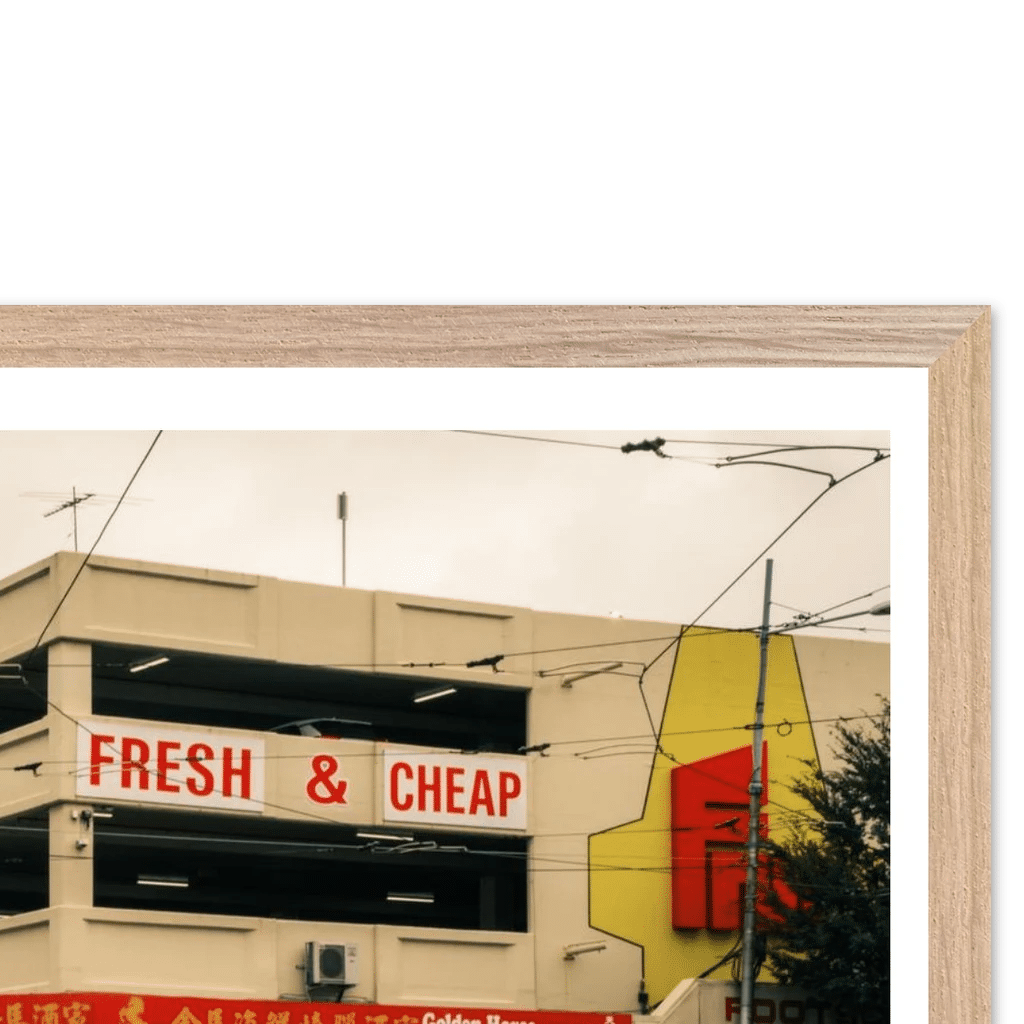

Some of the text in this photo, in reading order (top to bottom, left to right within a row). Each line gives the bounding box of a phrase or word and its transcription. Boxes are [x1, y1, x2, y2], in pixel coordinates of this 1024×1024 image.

[90, 733, 523, 818] FRESH & CHEAP
